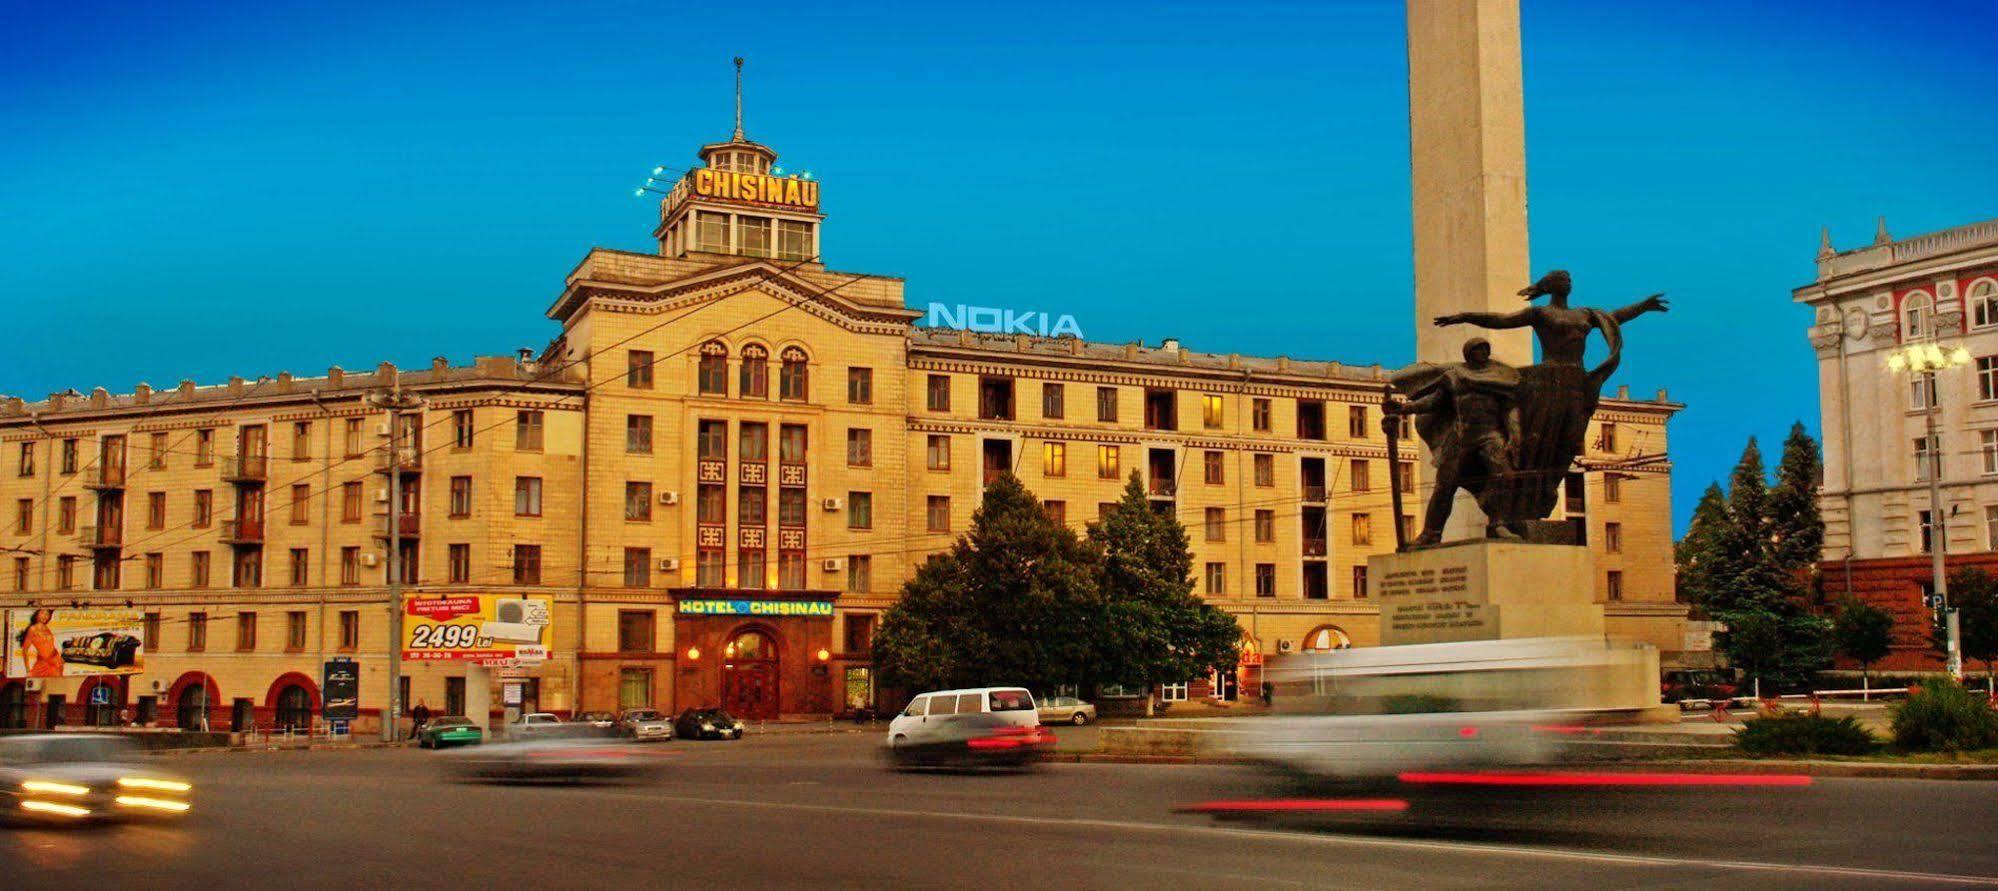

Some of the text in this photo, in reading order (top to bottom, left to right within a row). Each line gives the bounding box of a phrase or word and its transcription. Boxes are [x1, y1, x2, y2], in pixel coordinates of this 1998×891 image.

[929, 302, 1084, 339] NOKIA
[679, 601, 736, 614] HOTEL
[411, 625, 478, 648] 2499
